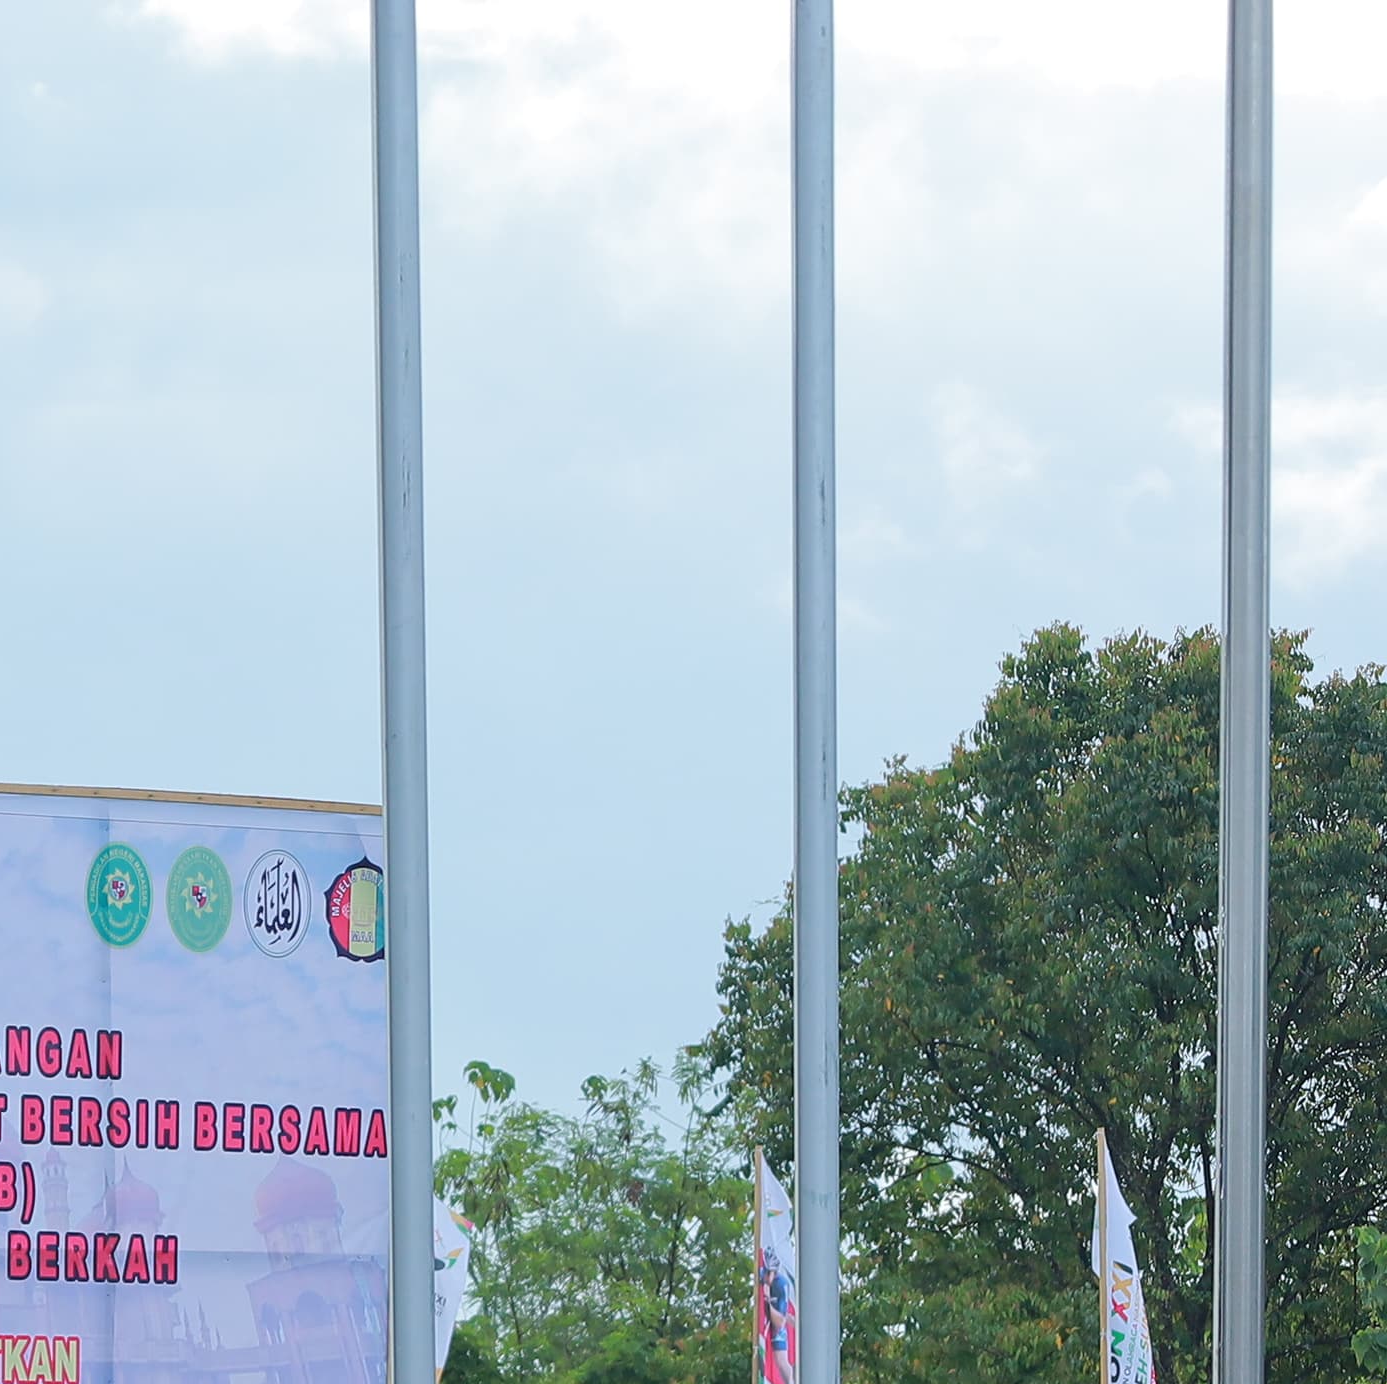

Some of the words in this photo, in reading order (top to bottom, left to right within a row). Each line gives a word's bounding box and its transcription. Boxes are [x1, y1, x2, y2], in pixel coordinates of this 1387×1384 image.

[20, 1095, 179, 1149] BERSIH
[194, 1102, 388, 1158] BERSAMA
[7, 1230, 178, 1284] BERKAH
